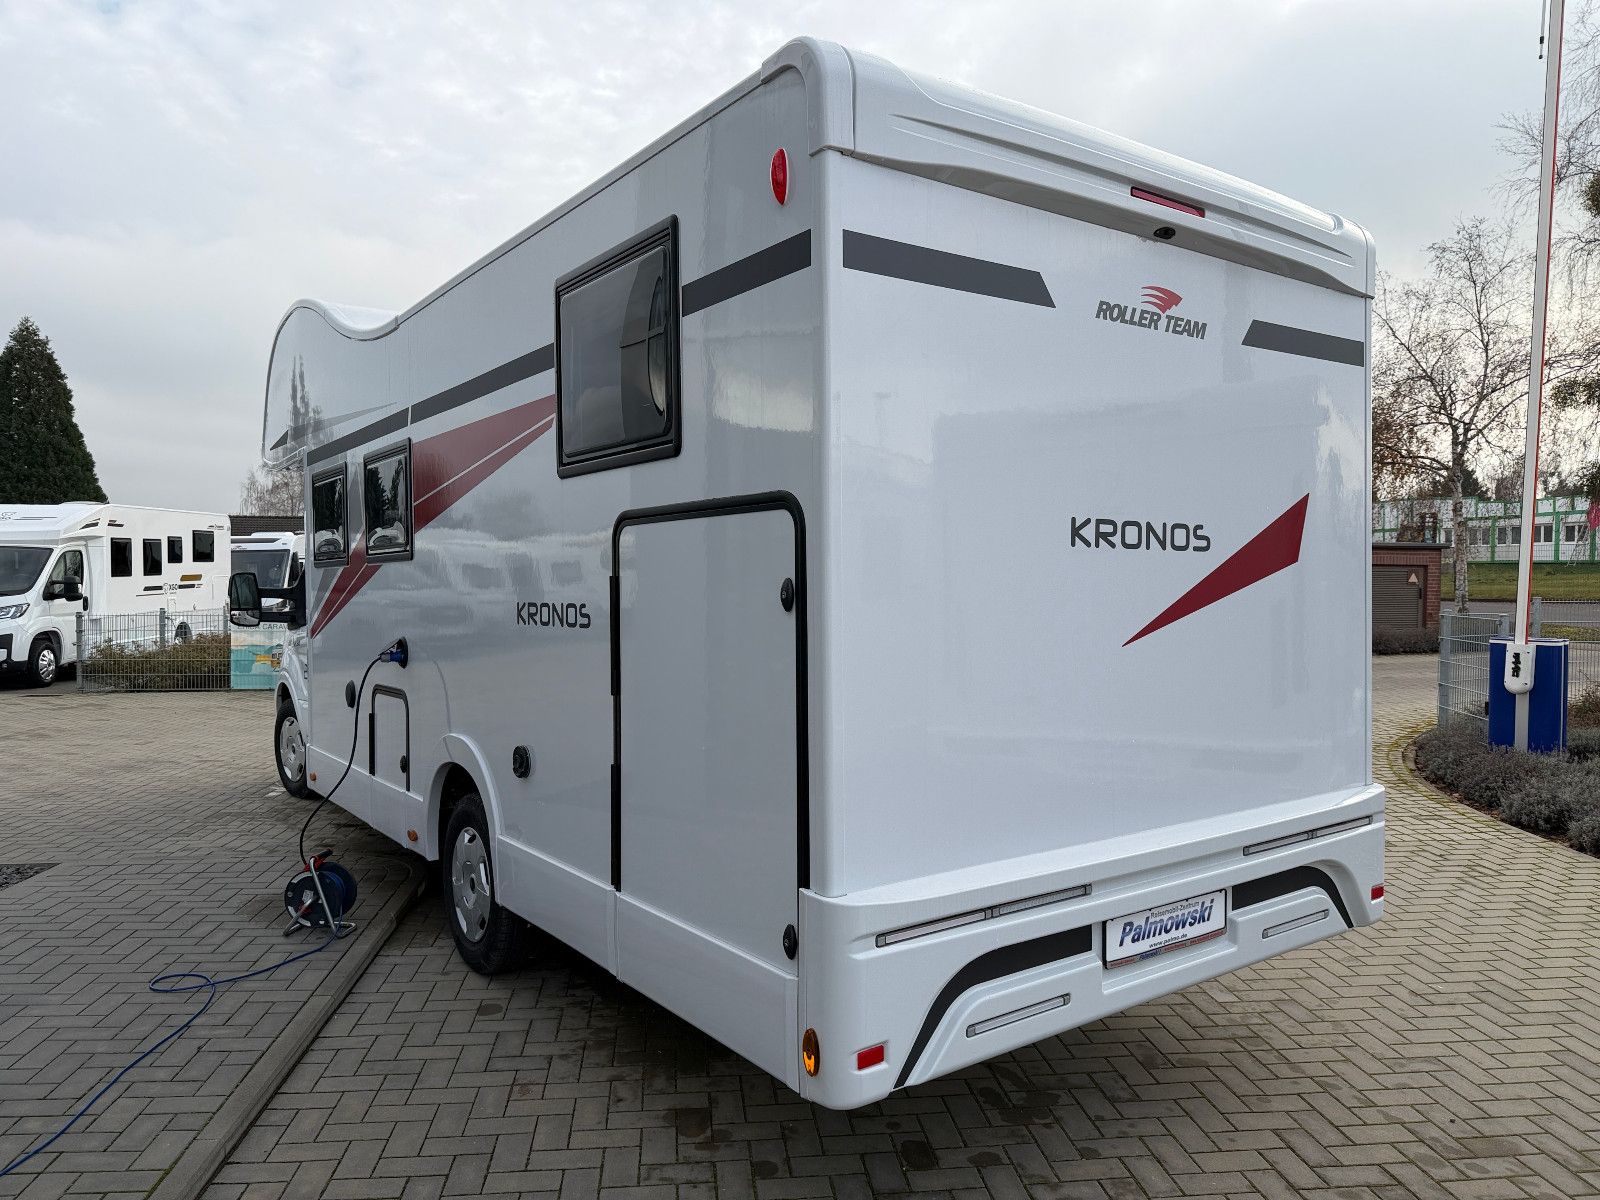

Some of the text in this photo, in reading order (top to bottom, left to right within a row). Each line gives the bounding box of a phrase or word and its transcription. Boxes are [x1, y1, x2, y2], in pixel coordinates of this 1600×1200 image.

[1094, 300, 1208, 340] ROLLER TEAM
[1070, 516, 1211, 552] KRONOS
[516, 602, 591, 629] KRONOS
[1118, 898, 1215, 947] Palmowski
[1148, 932, 1188, 949] www.palmo.de
